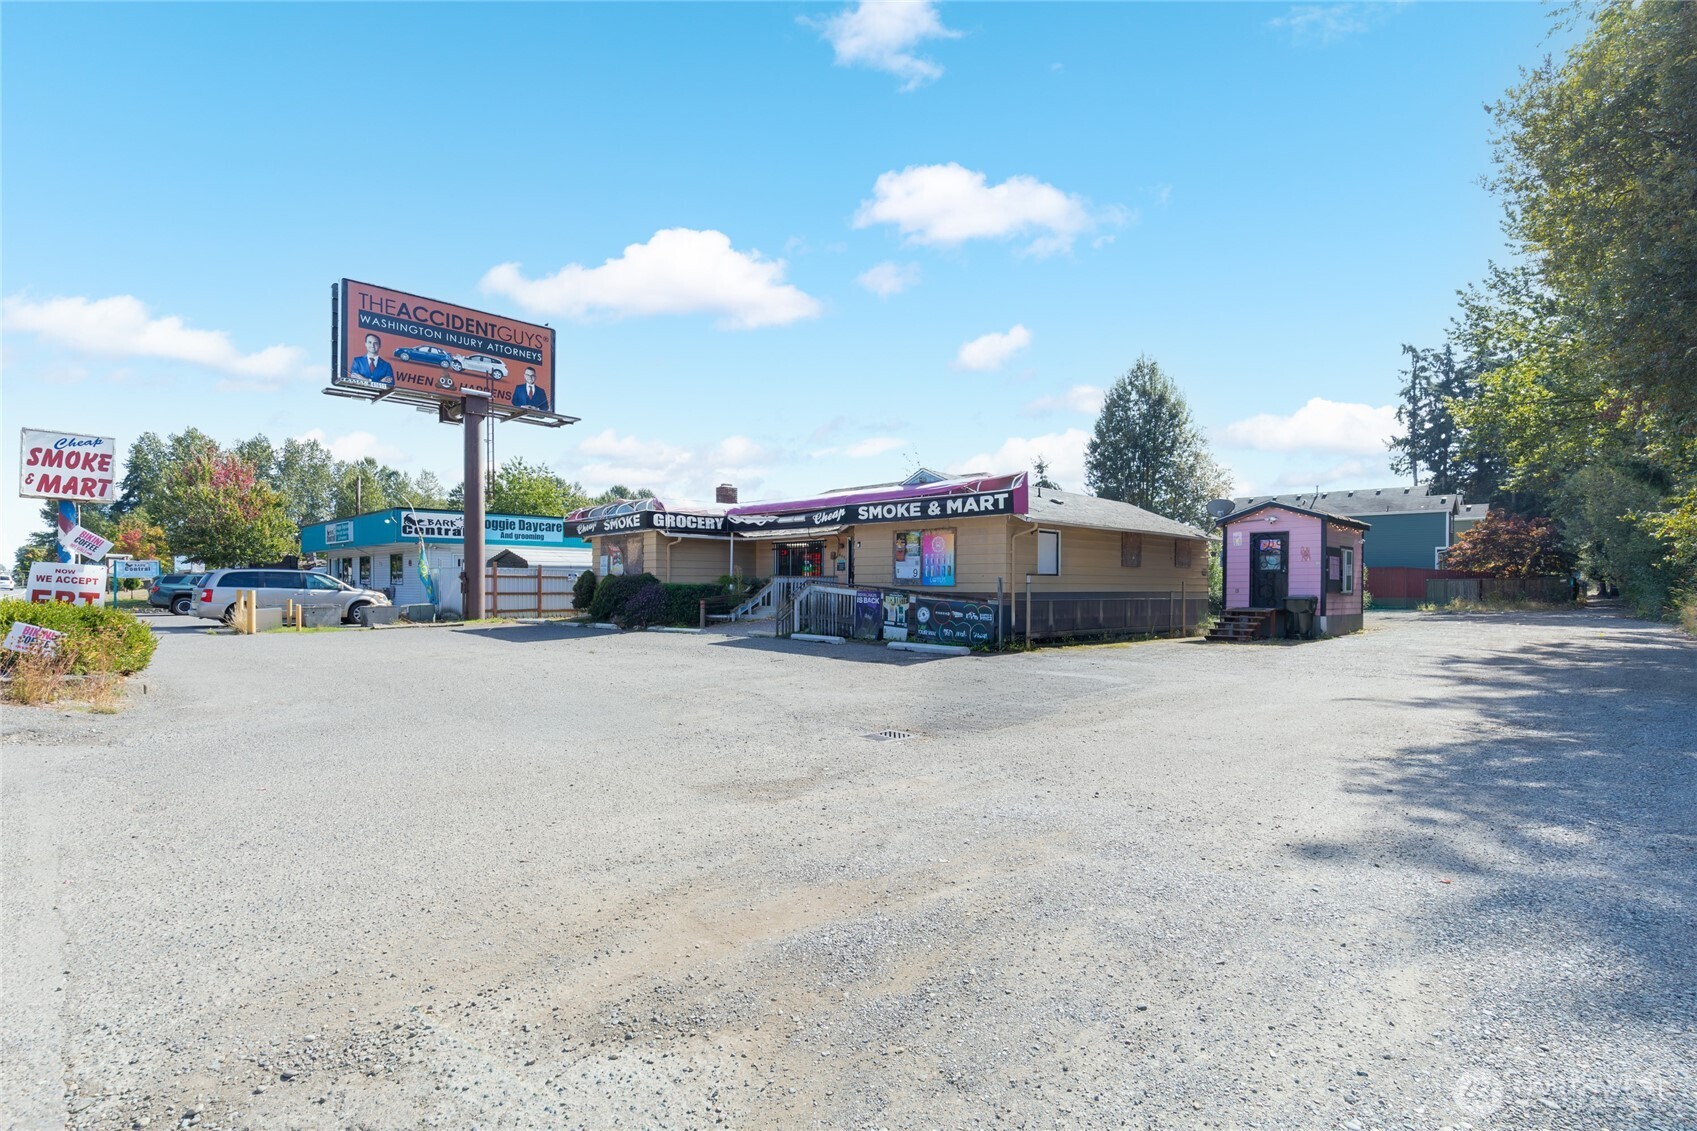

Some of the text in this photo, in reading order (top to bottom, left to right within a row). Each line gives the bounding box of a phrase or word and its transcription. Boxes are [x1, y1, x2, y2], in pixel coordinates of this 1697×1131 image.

[360, 314, 542, 361] WASHINGTON INJURY ATTORNEYS
[396, 371, 434, 386] WHEN
[54, 437, 104, 450] Cheap
[26, 447, 112, 472] SMOKE
[25, 473, 113, 498] & MART
[812, 493, 1009, 525] Cheap SMOKE & MART
[427, 518, 456, 528] BARK
[485, 519, 563, 533] oggie Daycare
[576, 514, 640, 534] Cheap SMOKE
[653, 513, 724, 530] GROCERY
[79, 530, 105, 547] BIKINI
[402, 525, 465, 537] Centra
[514, 533, 545, 541] grooming
[74, 536, 100, 553] COFFEE
[56, 576, 99, 585] ACCEPT
